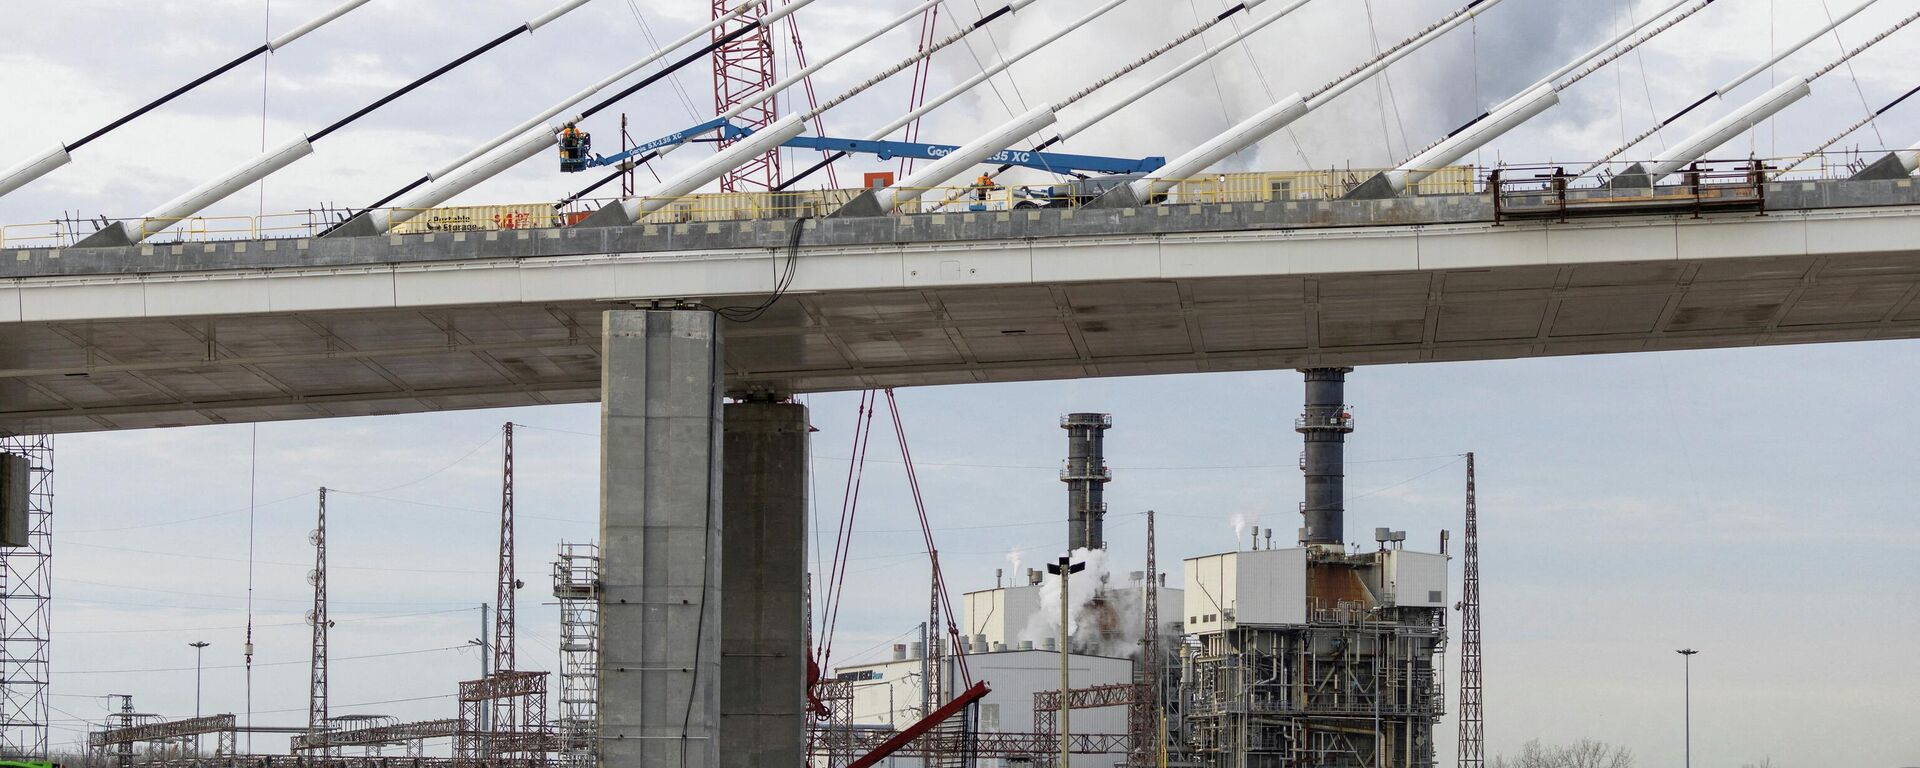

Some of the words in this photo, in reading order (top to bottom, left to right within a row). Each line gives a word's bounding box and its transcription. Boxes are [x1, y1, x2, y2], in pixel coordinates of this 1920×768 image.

[647, 137, 671, 149] SX-135
[672, 132, 682, 140] XC
[927, 145, 954, 157] Geni
[1011, 151, 1030, 163] XC
[433, 215, 470, 224] Portable
[443, 224, 477, 232] Storage
